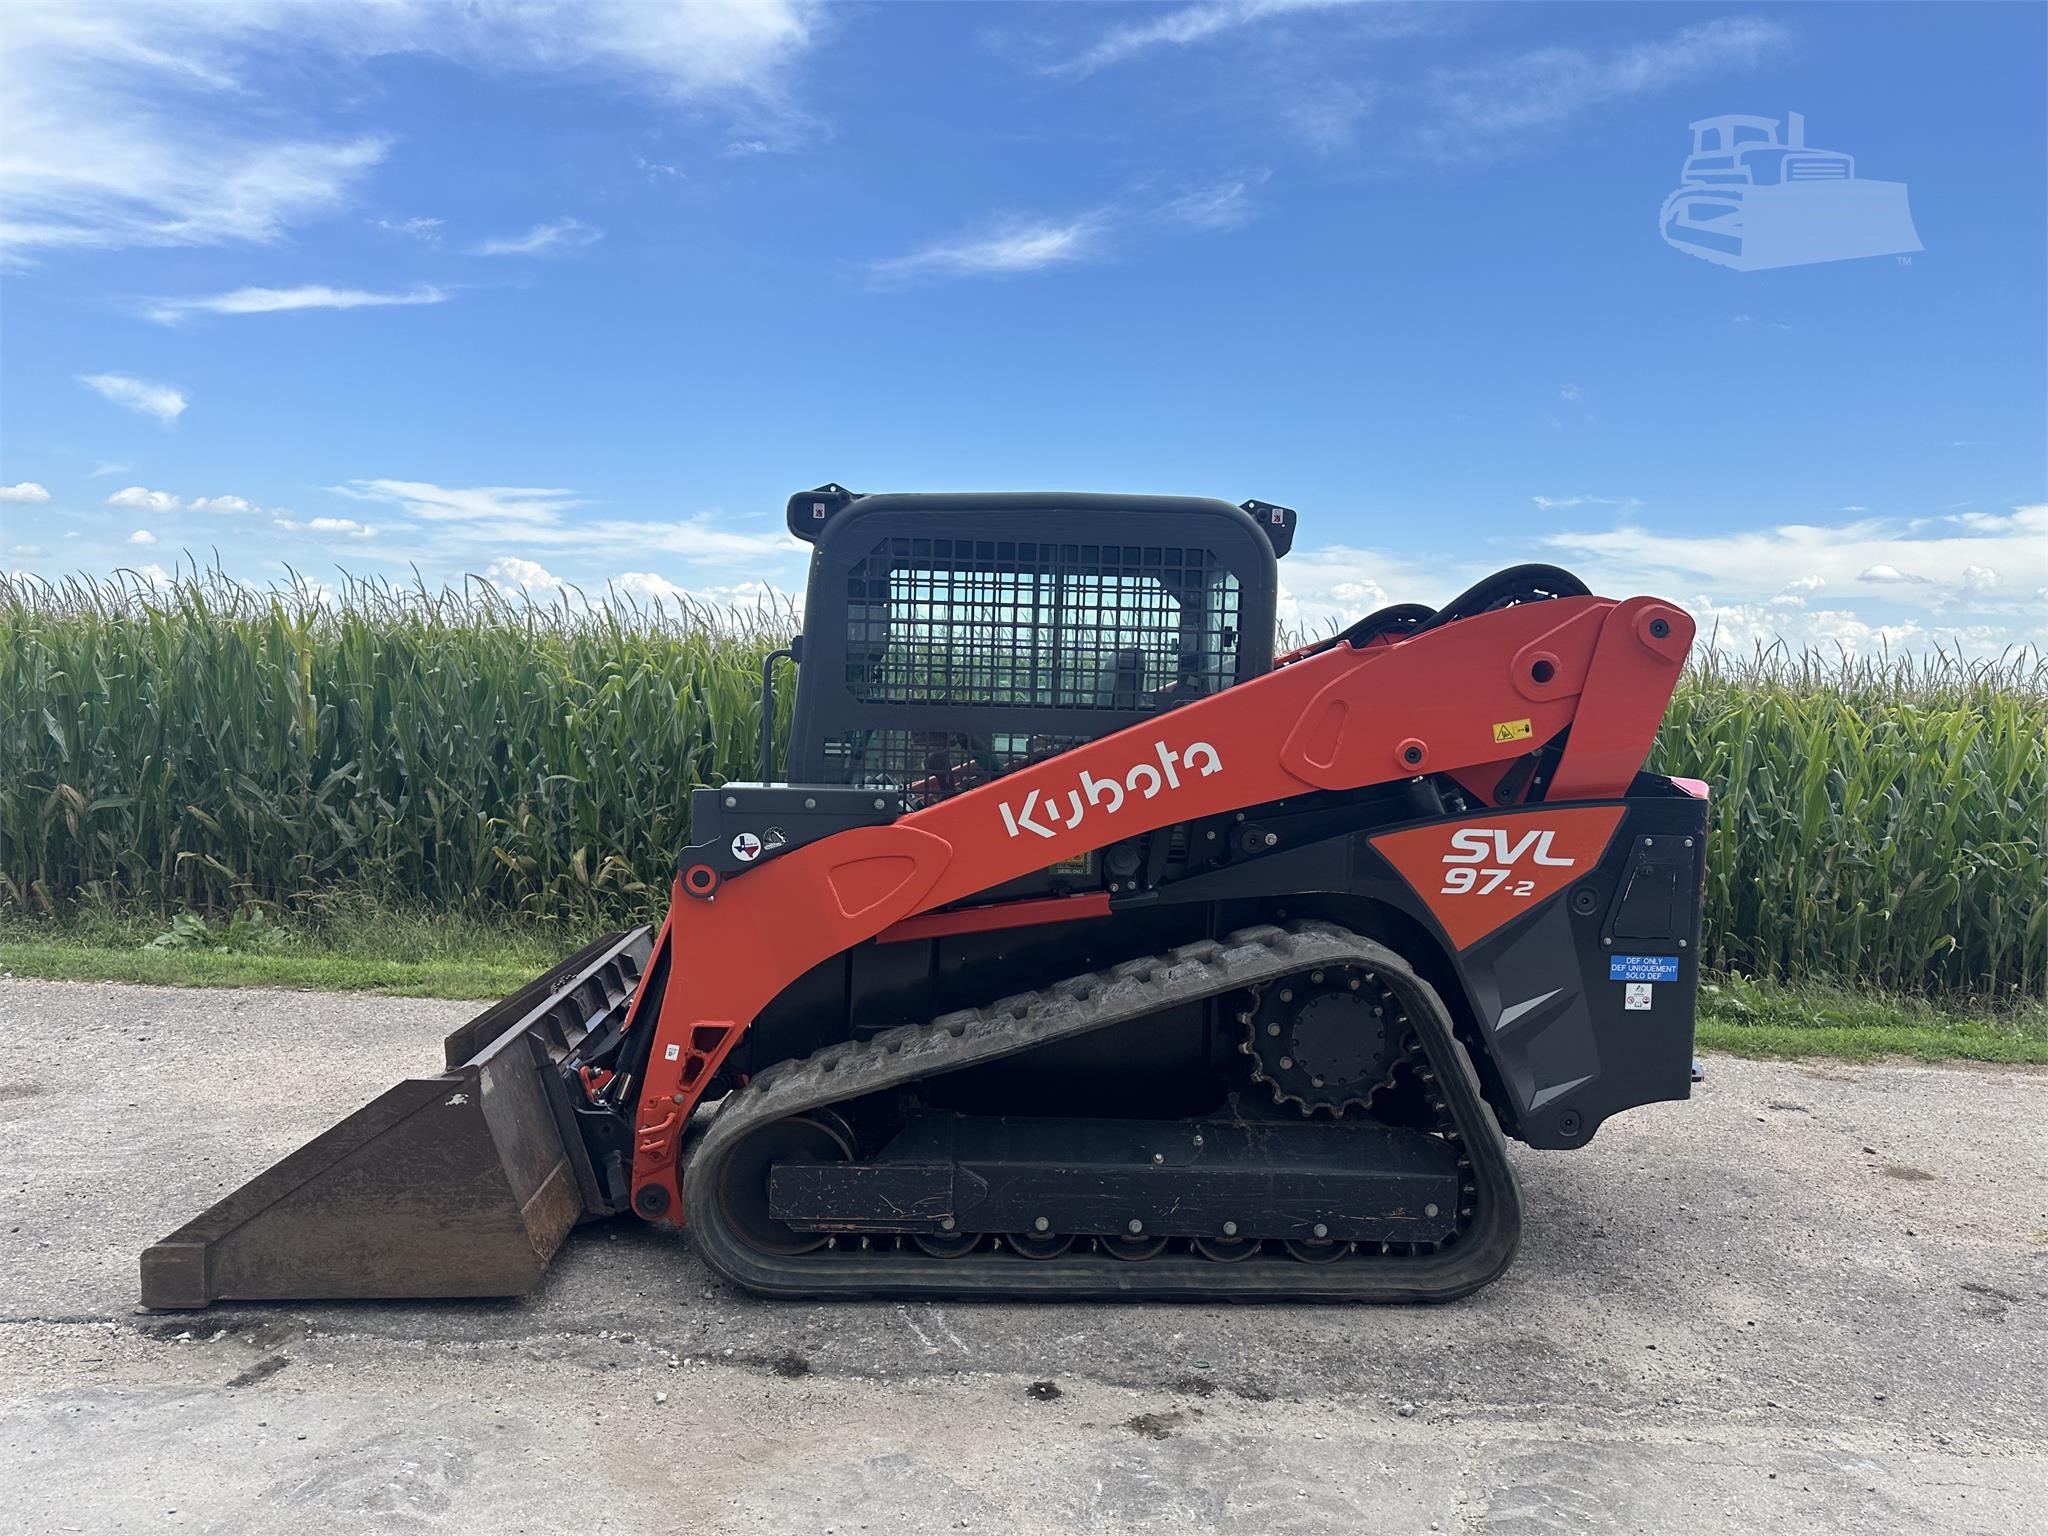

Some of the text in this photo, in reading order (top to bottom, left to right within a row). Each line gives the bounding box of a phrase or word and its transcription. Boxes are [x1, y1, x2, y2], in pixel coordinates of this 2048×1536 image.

[998, 740, 1223, 839] Kubota
[1441, 828, 1575, 867] SVL
[1440, 867, 1535, 897] 97-2
[1611, 964, 1677, 973] DEF UNIQUEMENT
[1626, 957, 1663, 965] DEF ONLY
[1625, 972, 1662, 980] SOLO DEF
